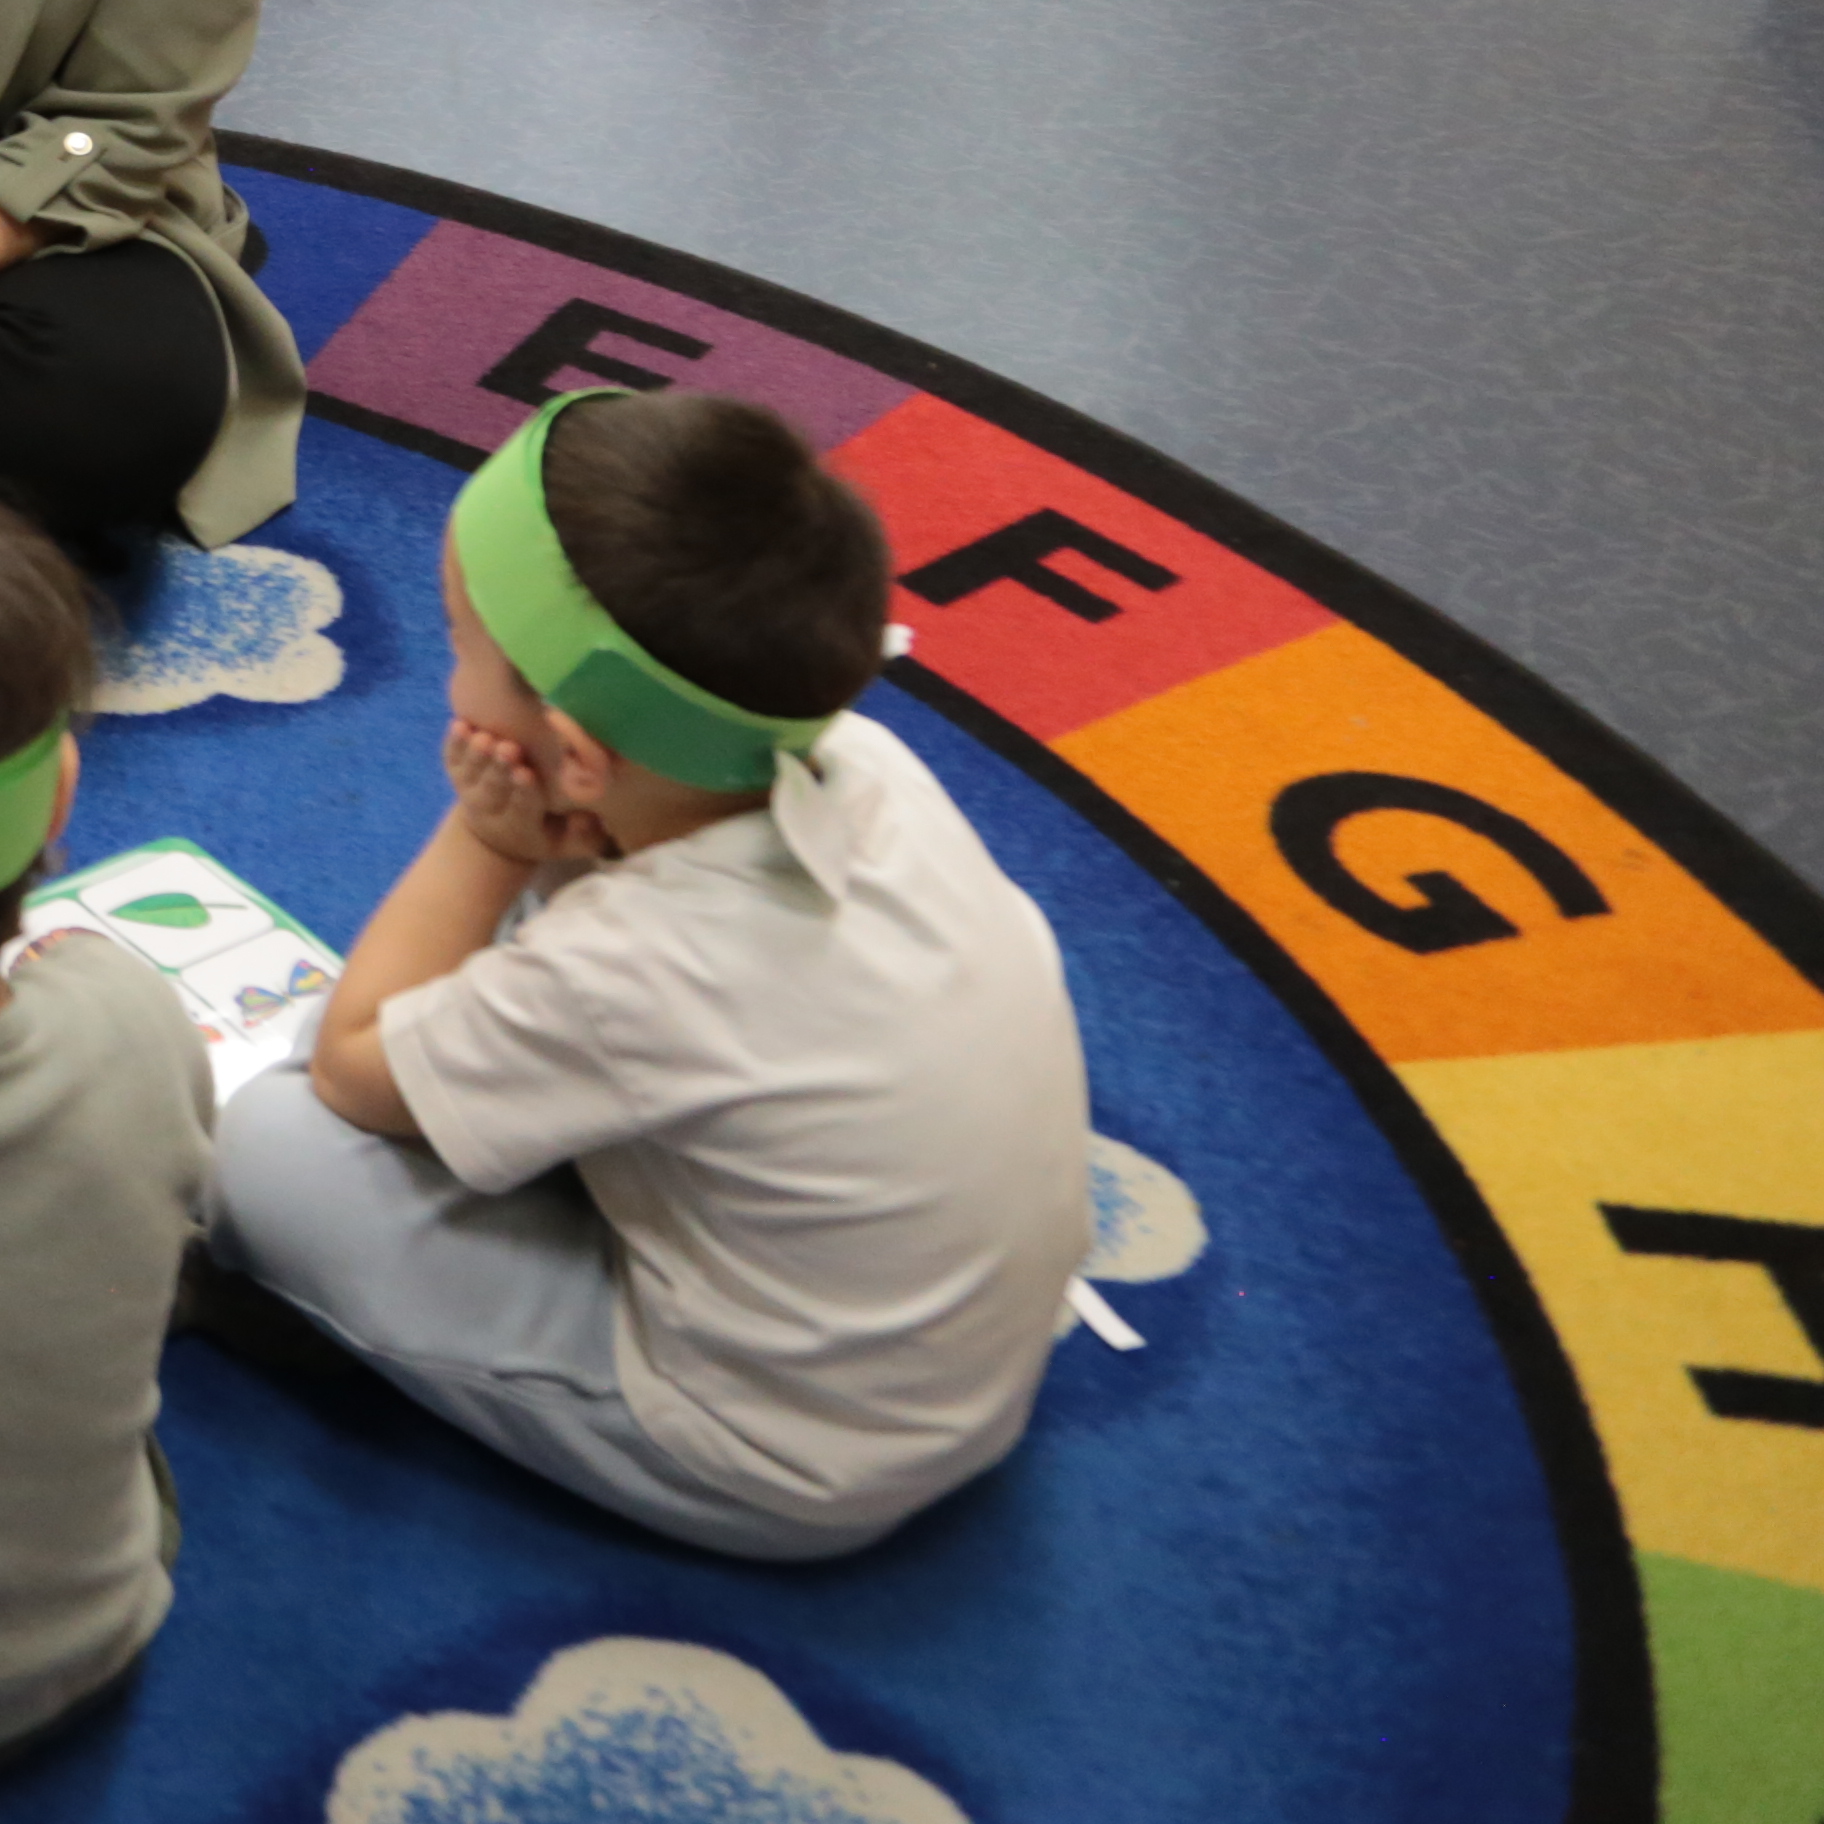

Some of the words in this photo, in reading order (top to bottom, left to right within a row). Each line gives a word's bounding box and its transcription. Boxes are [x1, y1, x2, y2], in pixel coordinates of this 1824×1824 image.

[474, 295, 712, 394] E
[896, 506, 1182, 625] F
[1266, 767, 1614, 959] G
